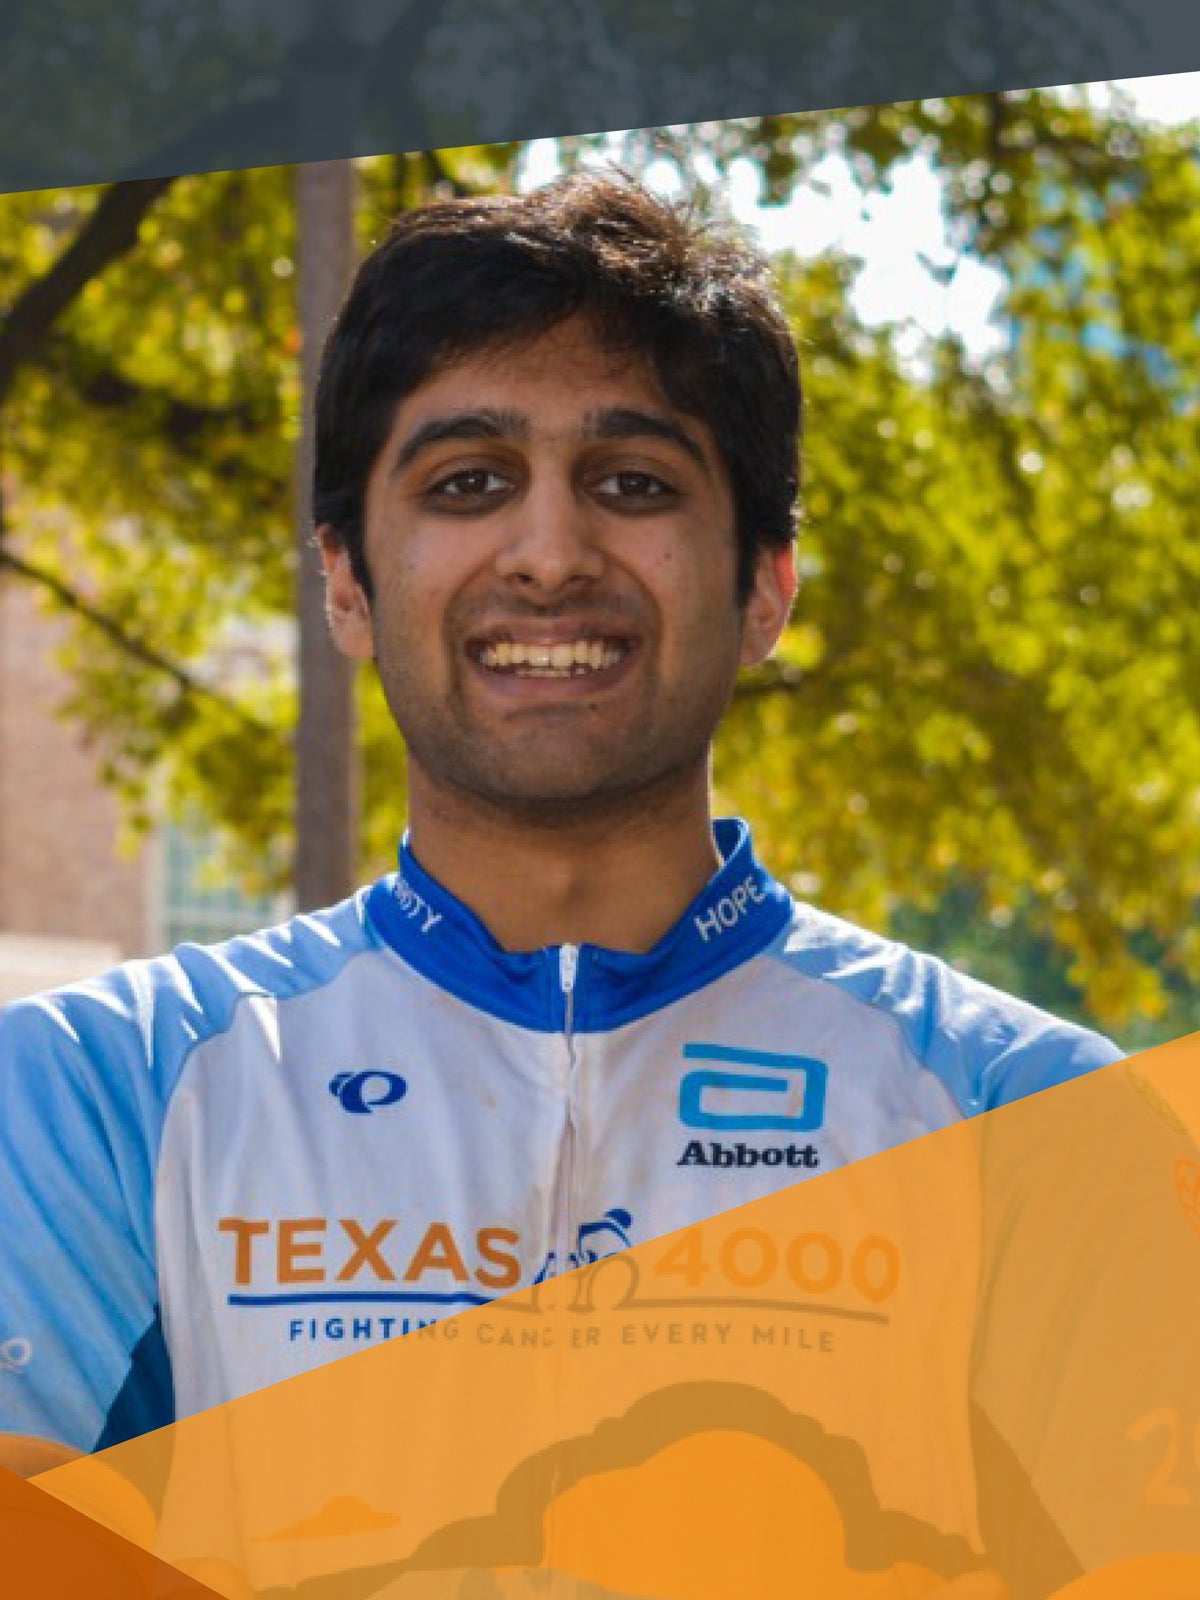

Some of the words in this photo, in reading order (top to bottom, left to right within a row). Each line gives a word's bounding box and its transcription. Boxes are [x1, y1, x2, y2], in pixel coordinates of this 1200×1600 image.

[694, 876, 766, 942] HOPE
[676, 1140, 819, 1169] Abbott
[218, 1216, 522, 1290] TEXAS
[653, 1227, 902, 1303] 4000
[289, 1316, 460, 1343] FIGHTING
[475, 1323, 602, 1349] CANCER
[621, 1322, 733, 1346] EVERY
[752, 1326, 836, 1354] MILE
